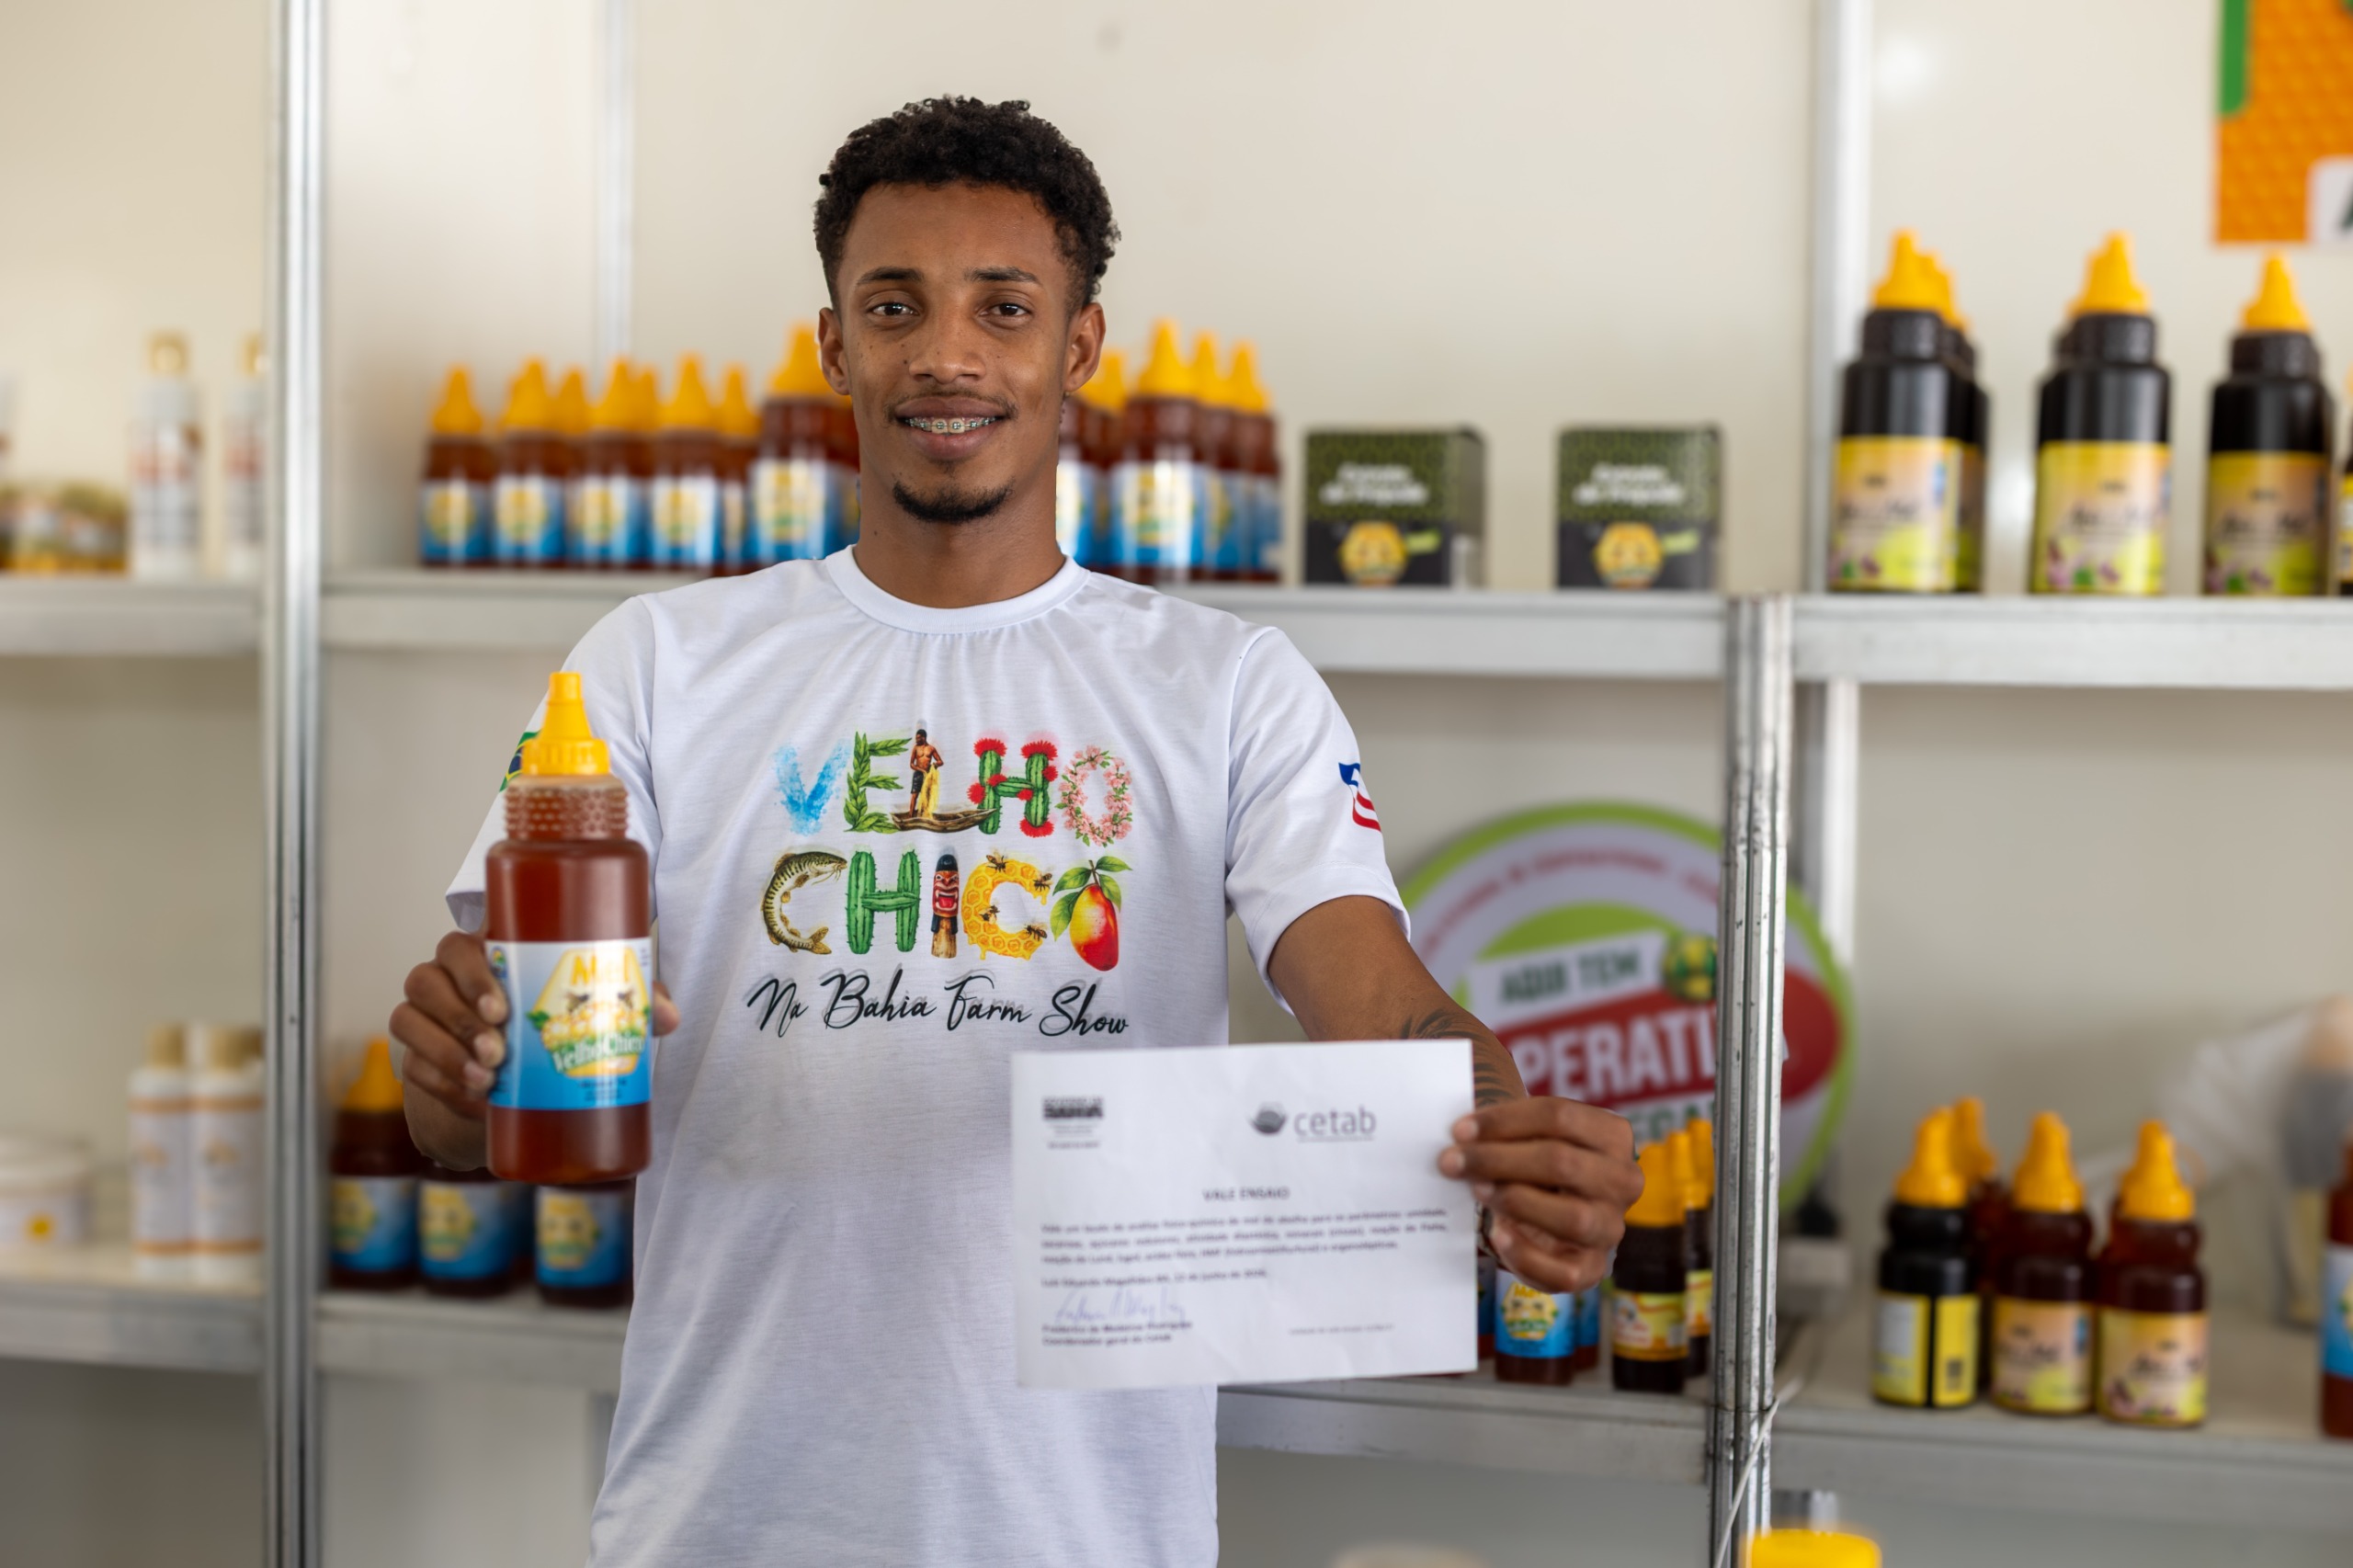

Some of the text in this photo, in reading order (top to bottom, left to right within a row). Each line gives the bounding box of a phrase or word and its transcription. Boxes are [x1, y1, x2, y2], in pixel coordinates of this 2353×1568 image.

[774, 729, 1132, 846] VELHO
[762, 847, 1132, 971] CHICO
[747, 969, 1130, 1037] Na Bahia Farm Show
[1293, 1104, 1377, 1136] cetab
[1201, 1186, 1290, 1201] VALE ENSAIO
